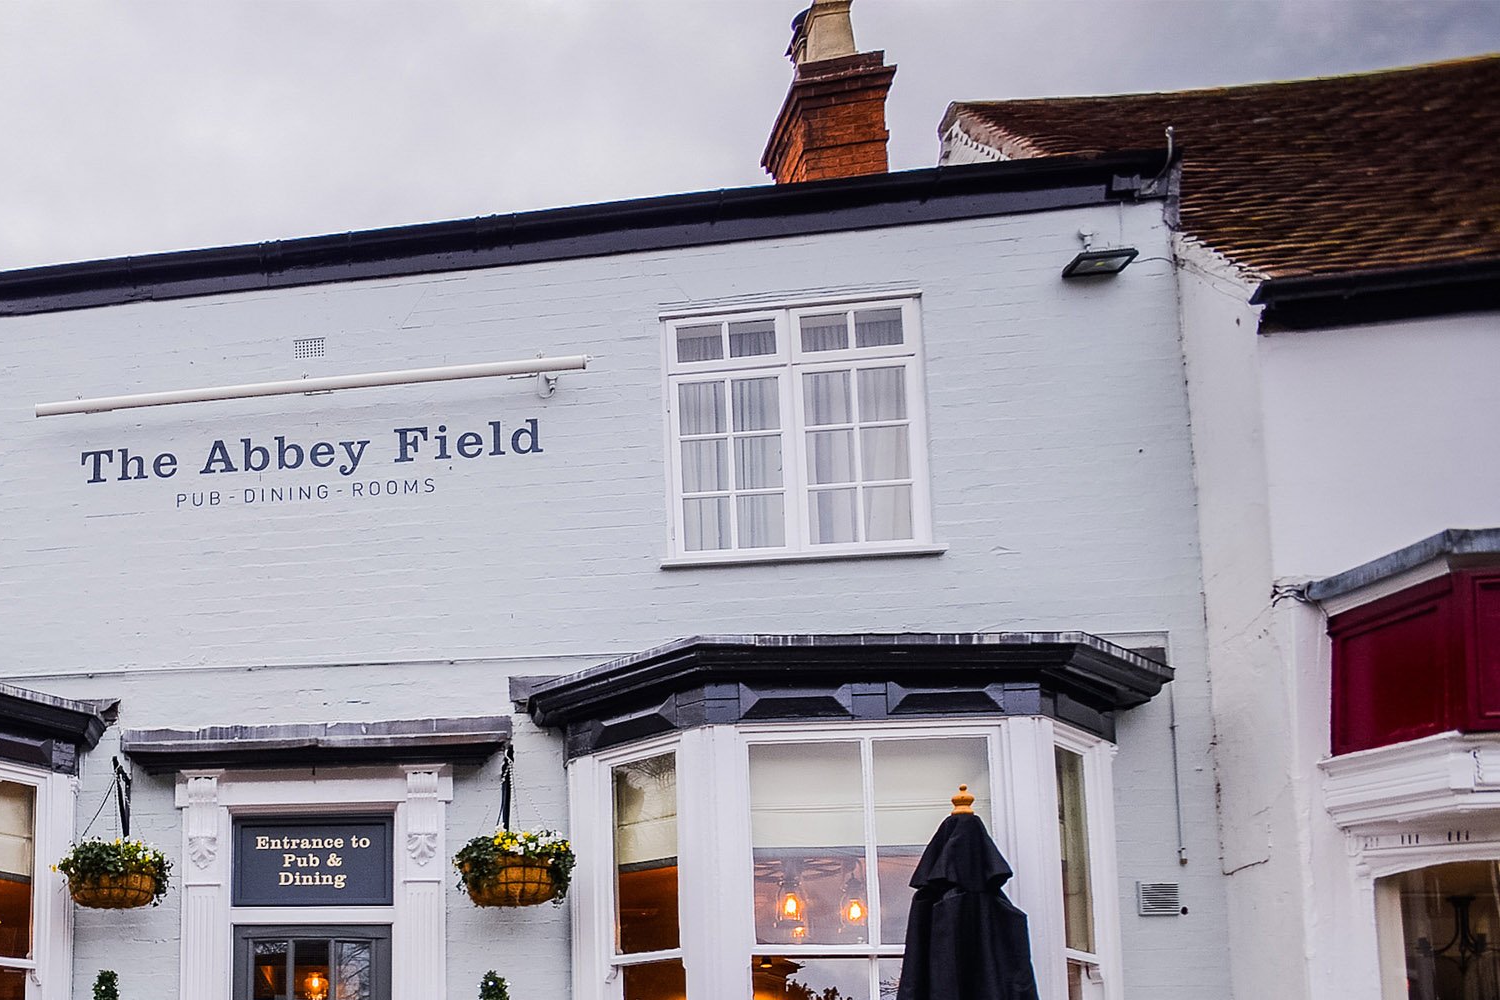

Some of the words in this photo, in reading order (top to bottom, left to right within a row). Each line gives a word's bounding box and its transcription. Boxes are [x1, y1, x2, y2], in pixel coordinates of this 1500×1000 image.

[81, 448, 178, 483] The
[200, 436, 371, 476] Abbey
[394, 419, 544, 462] Field
[256, 836, 344, 850] Entrance
[351, 835, 370, 848] to
[283, 854, 319, 867] Pub
[326, 853, 342, 866] &
[279, 872, 346, 888] Dining
